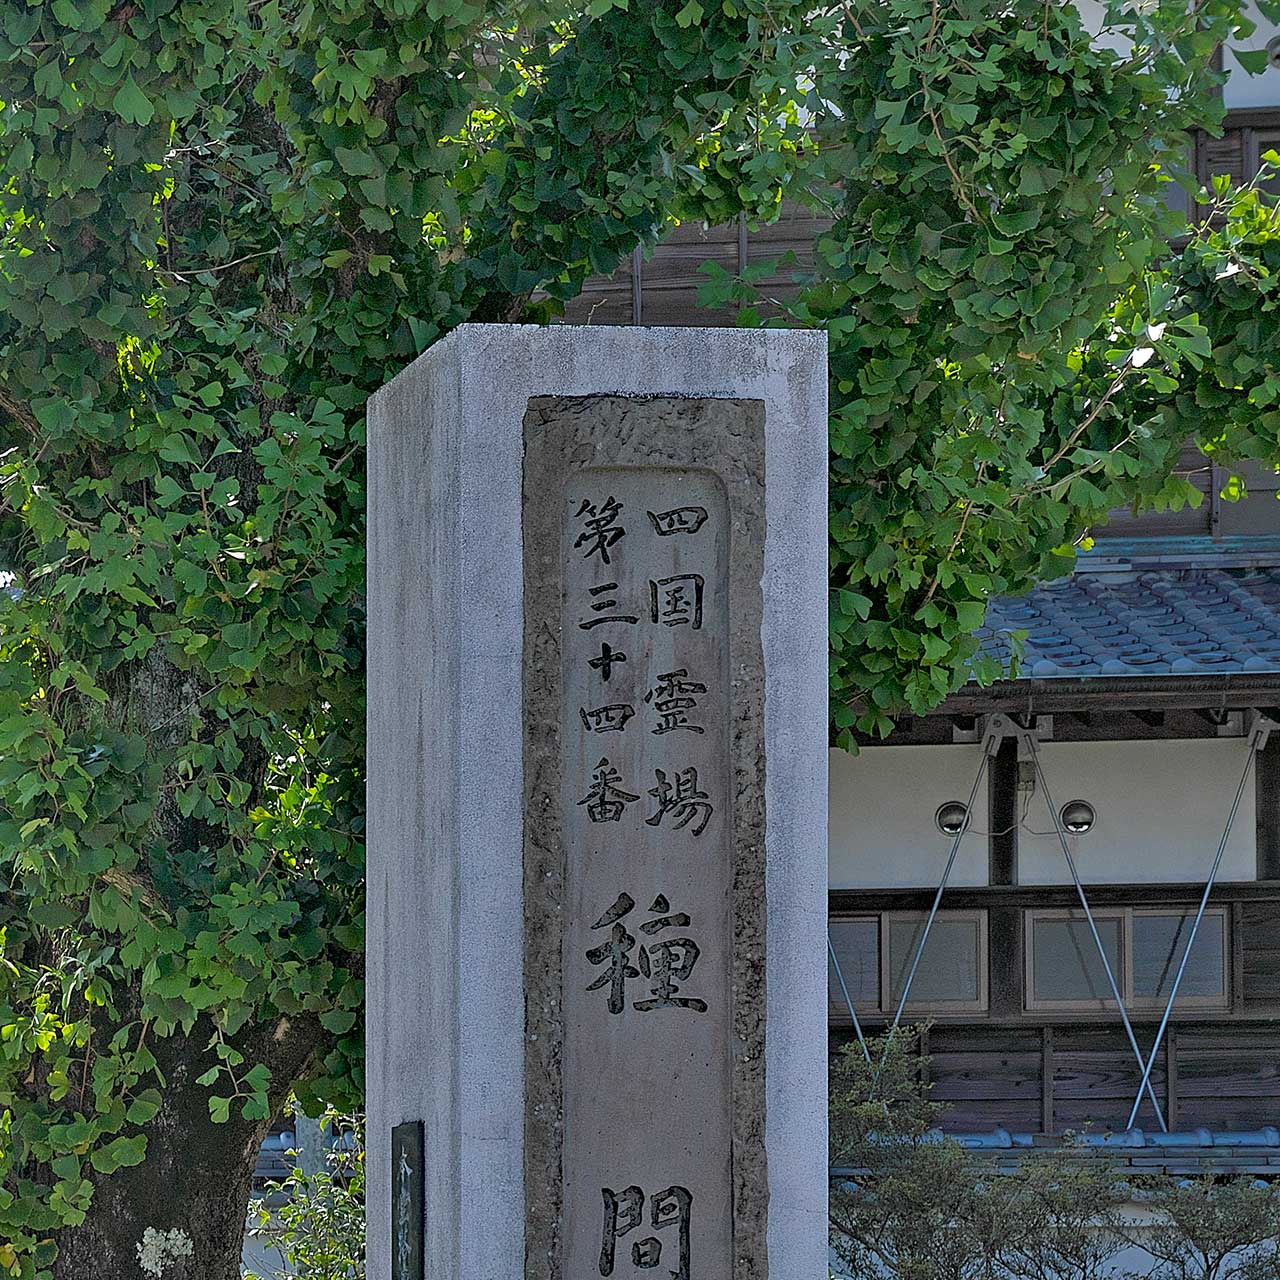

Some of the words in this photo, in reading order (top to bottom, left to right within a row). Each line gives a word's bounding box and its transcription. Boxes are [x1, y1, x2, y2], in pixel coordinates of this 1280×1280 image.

[572, 495, 641, 824] 第三十四番
[644, 504, 714, 838] 四国霊場
